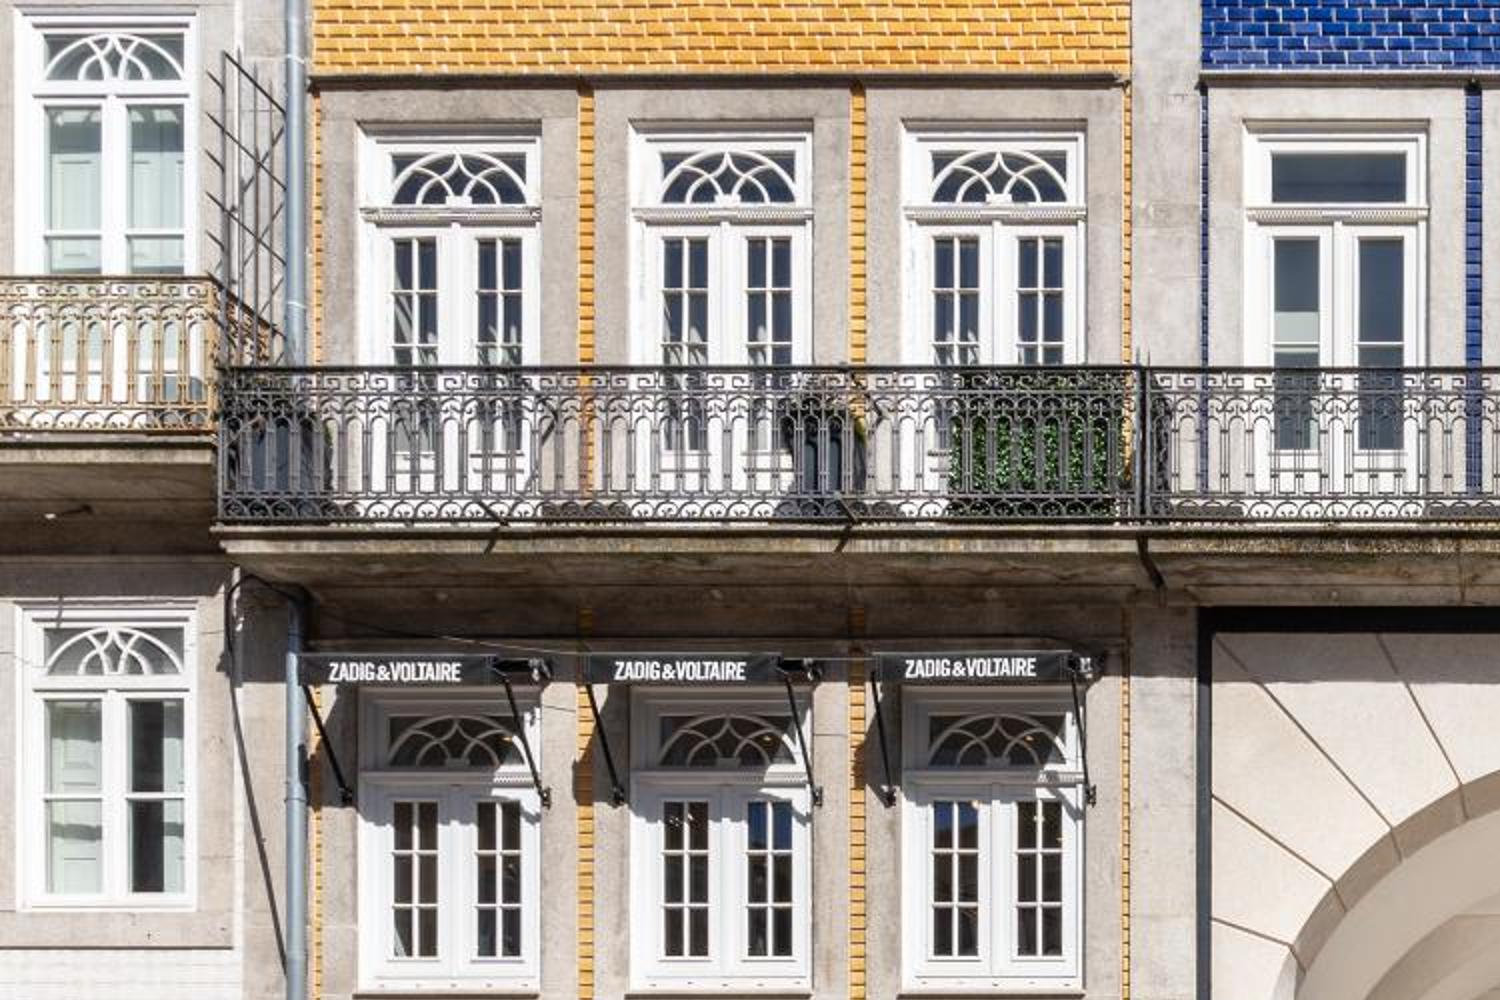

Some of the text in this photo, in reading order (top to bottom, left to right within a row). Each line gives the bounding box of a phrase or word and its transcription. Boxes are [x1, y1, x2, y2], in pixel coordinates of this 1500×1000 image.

[328, 661, 462, 683] ZADIG&VOLTAIRE
[613, 660, 747, 681] ZADIG&VOLTAIRE
[905, 657, 1037, 679] ZADIG&VOLTAIRE
